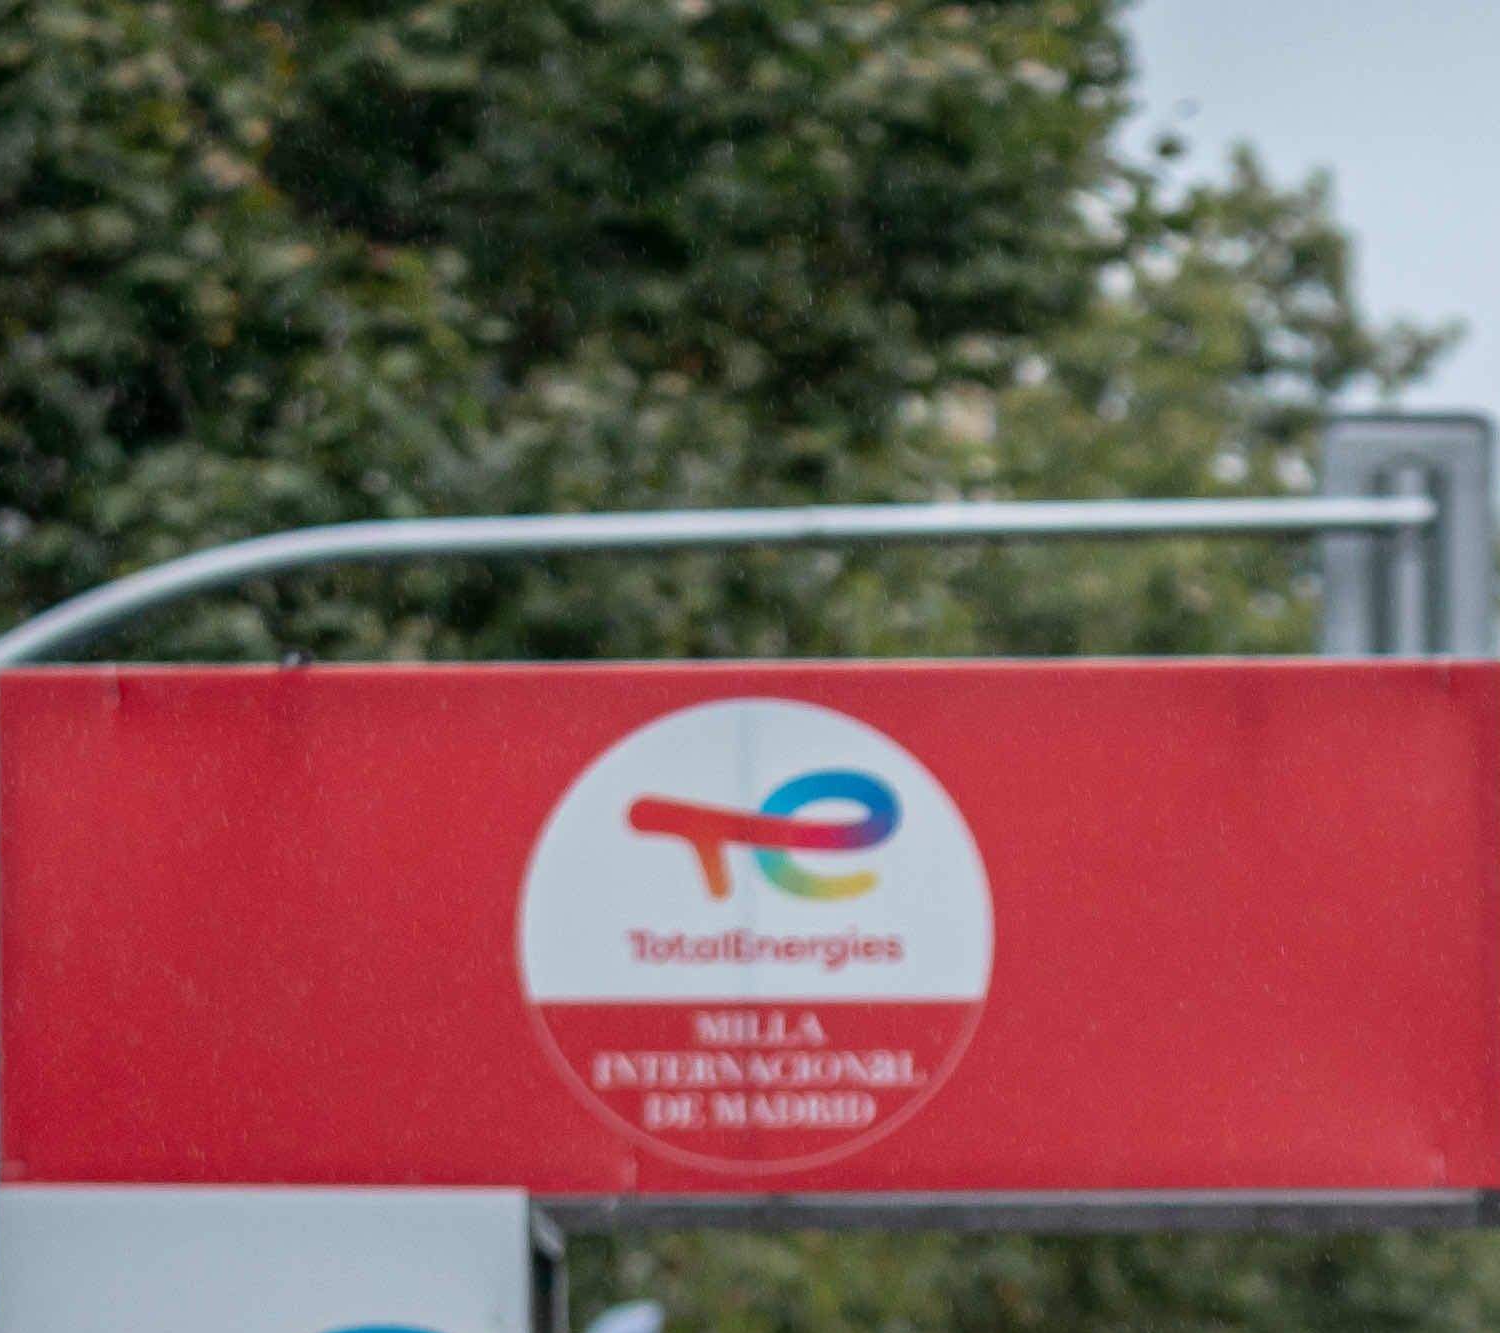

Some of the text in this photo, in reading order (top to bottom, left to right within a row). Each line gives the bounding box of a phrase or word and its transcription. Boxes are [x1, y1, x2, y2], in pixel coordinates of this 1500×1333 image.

[627, 926, 904, 972] TotalEnergies
[694, 1010, 827, 1046] MILLA
[644, 1091, 877, 1130] DE MADRID
